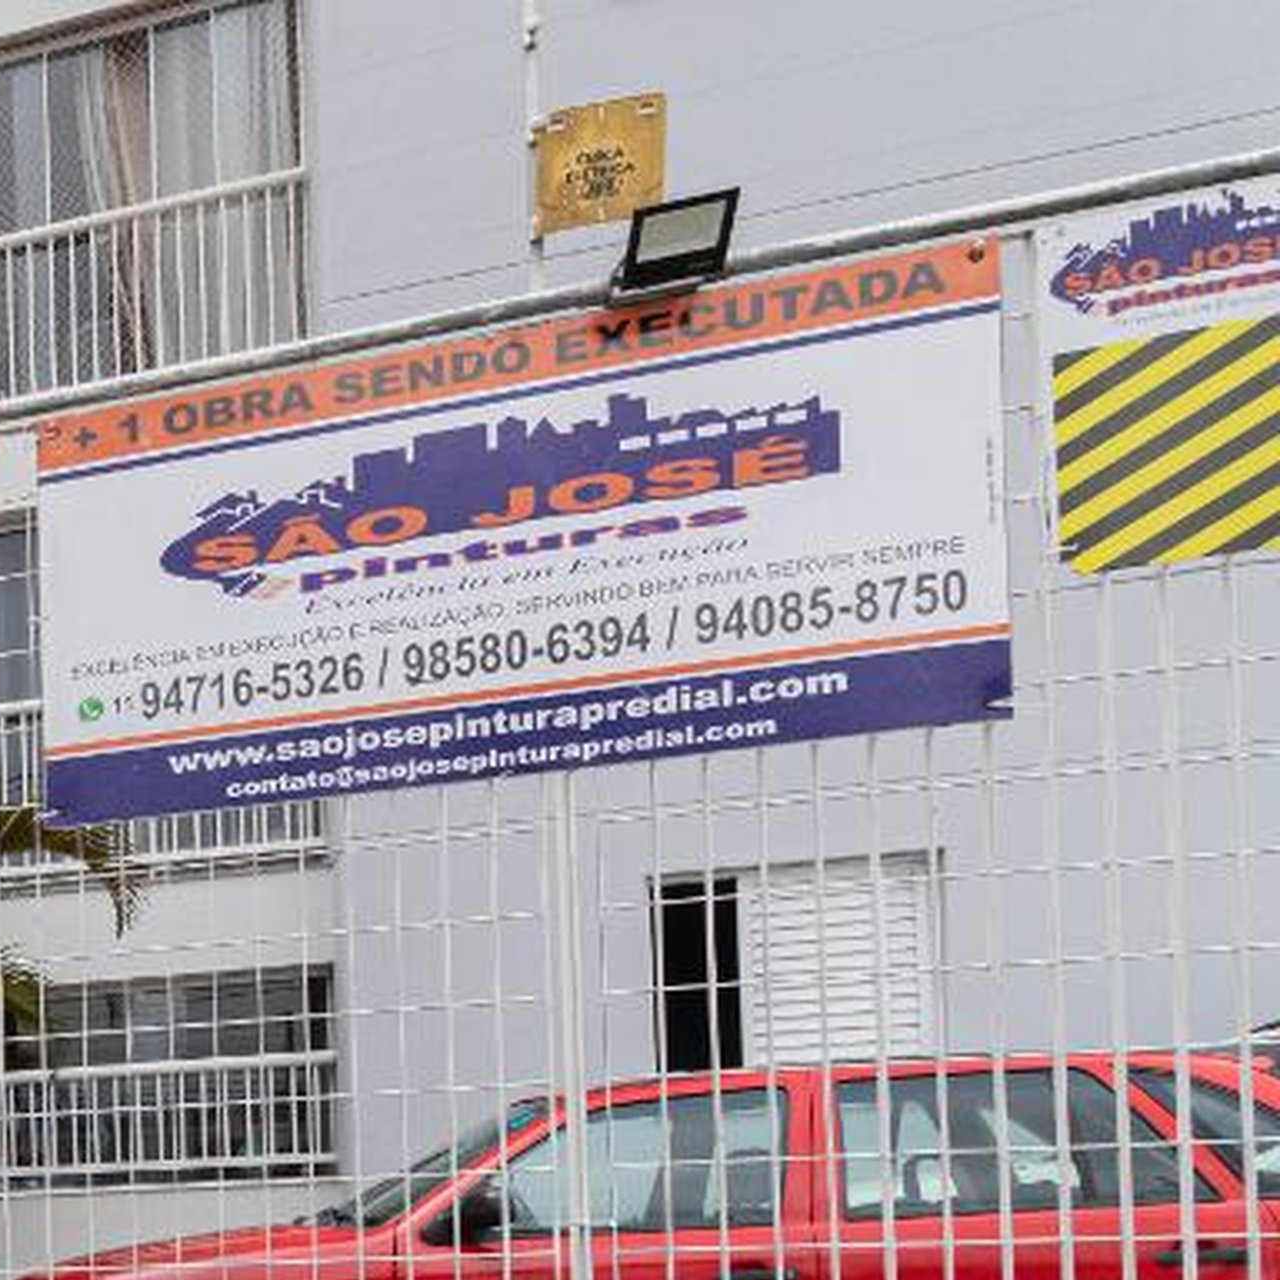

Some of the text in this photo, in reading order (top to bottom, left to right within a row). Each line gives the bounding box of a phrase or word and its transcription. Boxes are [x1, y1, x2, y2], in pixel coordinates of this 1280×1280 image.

[1177, 233, 1280, 275] JOS
[119, 415, 139, 442] 1
[162, 381, 313, 436] OBRA
[334, 339, 531, 403] SENDO
[555, 260, 946, 366] EXECUTADA
[192, 433, 810, 572] SÃO JOSÉ
[297, 505, 748, 594] pinturas
[516, 580, 634, 615] SERVINDO
[639, 576, 688, 598] BEM
[696, 566, 758, 590] PARA
[767, 550, 854, 581] SERVIR
[863, 535, 966, 566] SEMPRE
[140, 651, 365, 720] 94716-5326
[378, 645, 389, 688] /
[403, 611, 651, 684] 98580-6394
[667, 605, 679, 650] /
[695, 568, 968, 645] 94085-8750
[167, 667, 851, 776] www.saojosepinturapredial.com
[224, 715, 779, 799] contato@saojosepinturapredial.com
